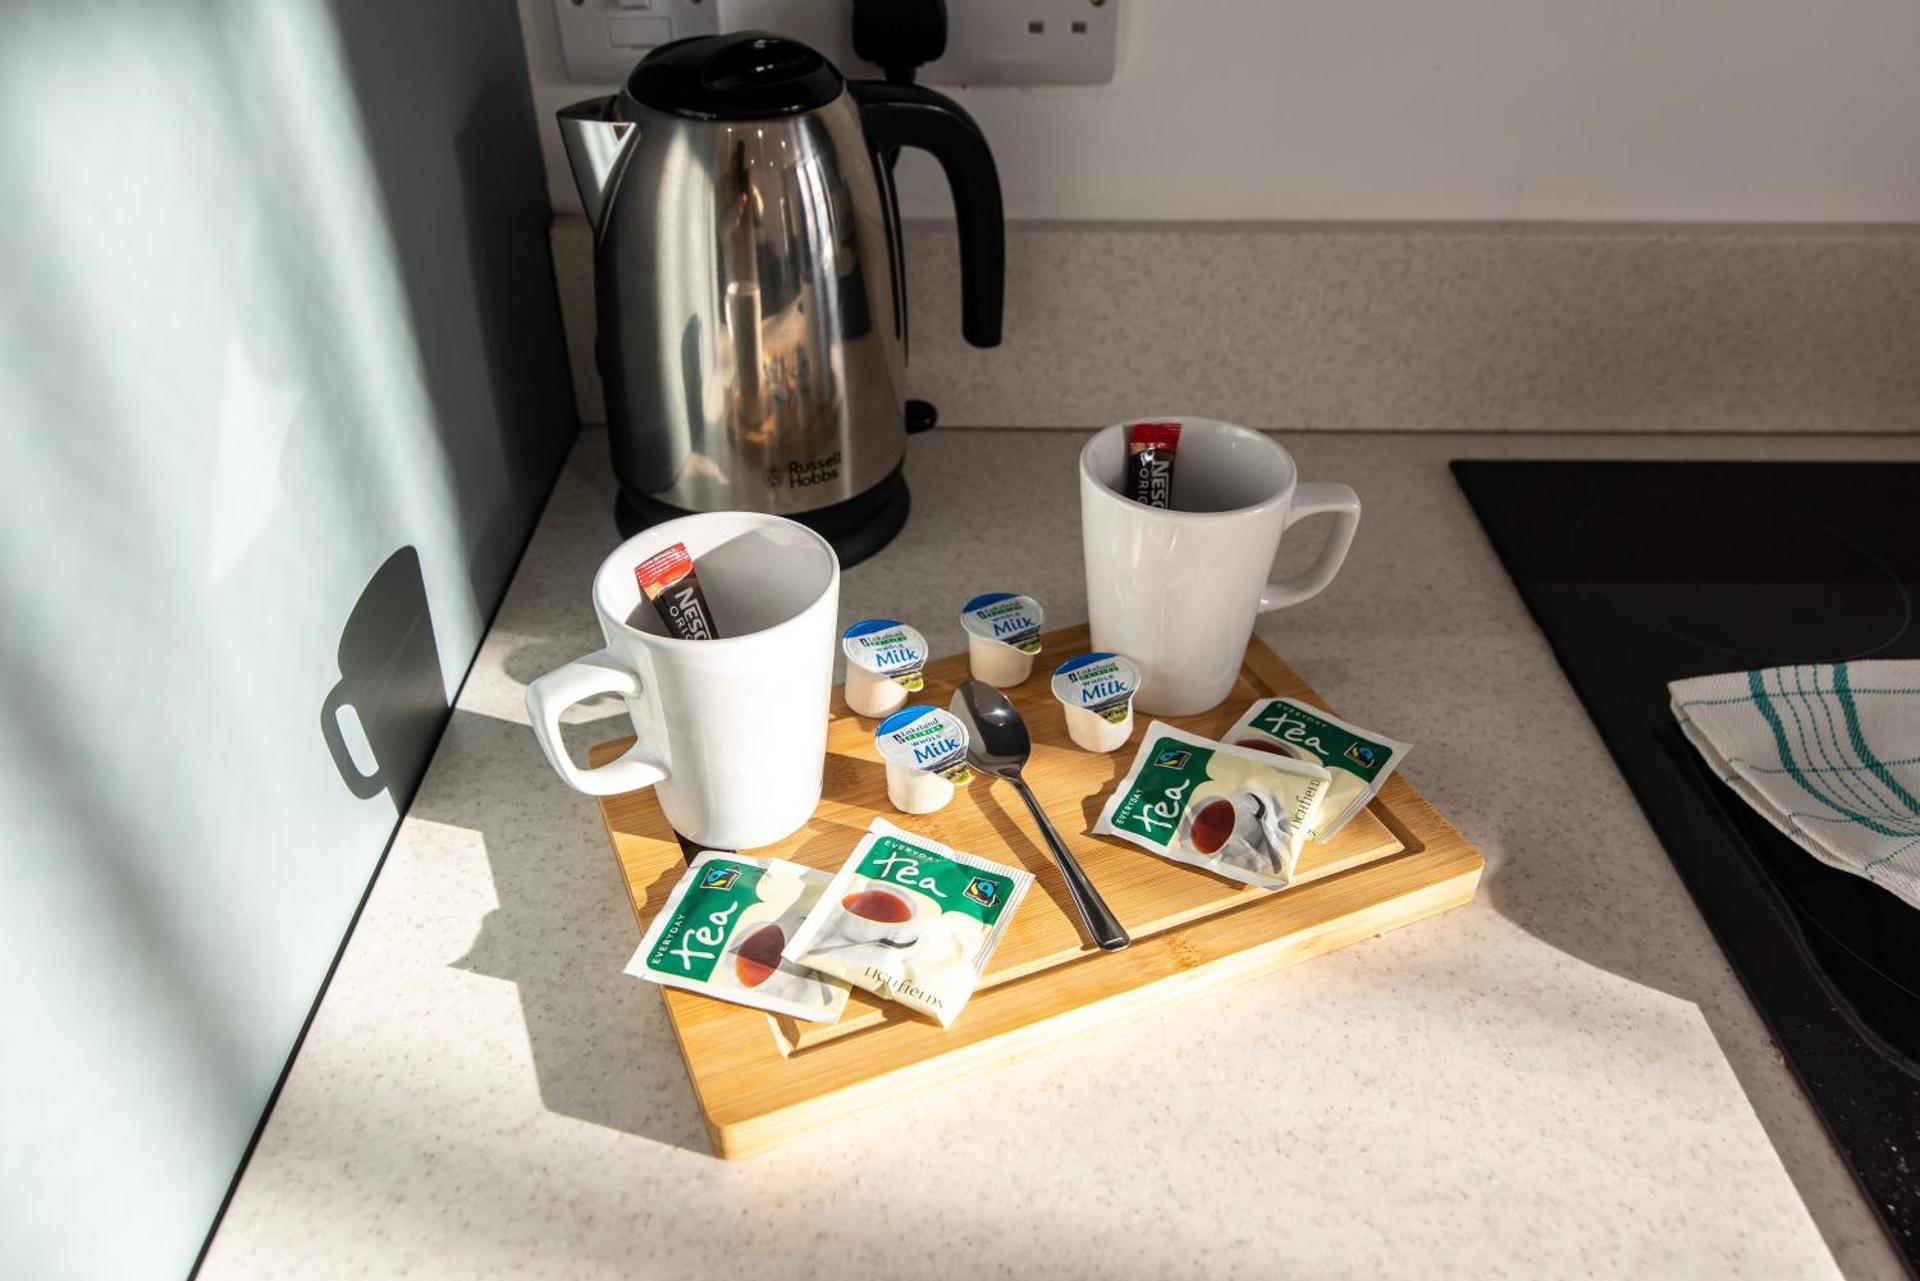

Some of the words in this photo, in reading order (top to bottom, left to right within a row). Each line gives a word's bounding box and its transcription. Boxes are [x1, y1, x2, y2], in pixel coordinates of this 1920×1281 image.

[788, 449, 843, 475] Russell
[789, 468, 839, 489] Hobbs
[993, 616, 1035, 636] Milk
[876, 648, 918, 667] Milk
[1082, 680, 1127, 702] Milk
[914, 738, 960, 763] Milk
[1117, 789, 1143, 824] EVERYDAY
[884, 839, 947, 863] EVERYDAY
[652, 913, 686, 965] EVERYDAY
